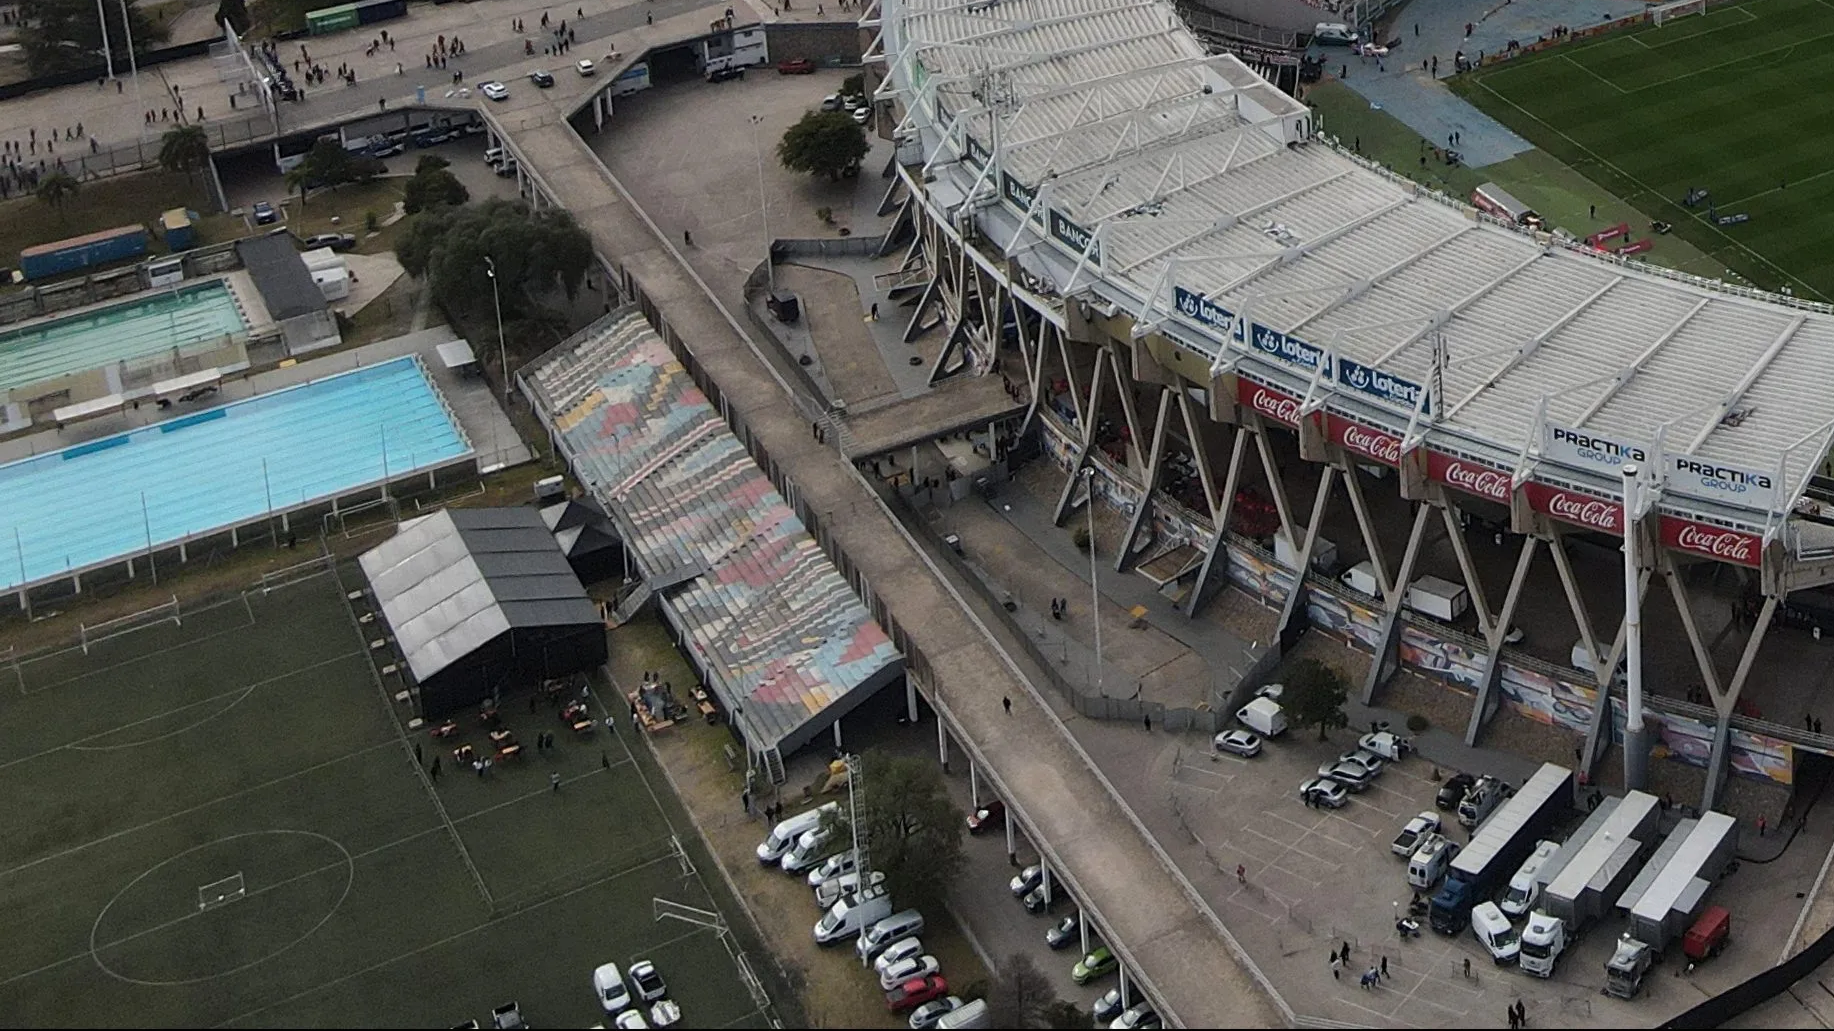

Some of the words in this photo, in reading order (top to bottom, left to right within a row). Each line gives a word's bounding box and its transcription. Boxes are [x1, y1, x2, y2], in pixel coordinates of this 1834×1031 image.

[1343, 425, 1401, 462] Coca-Cola
[1577, 447, 1622, 466] GROUP
[1446, 461, 1511, 499] Coca-Cola
[1701, 476, 1747, 494] GROUP
[1549, 492, 1618, 528] Coca-Cola
[1678, 525, 1752, 560] Coca-Cola
